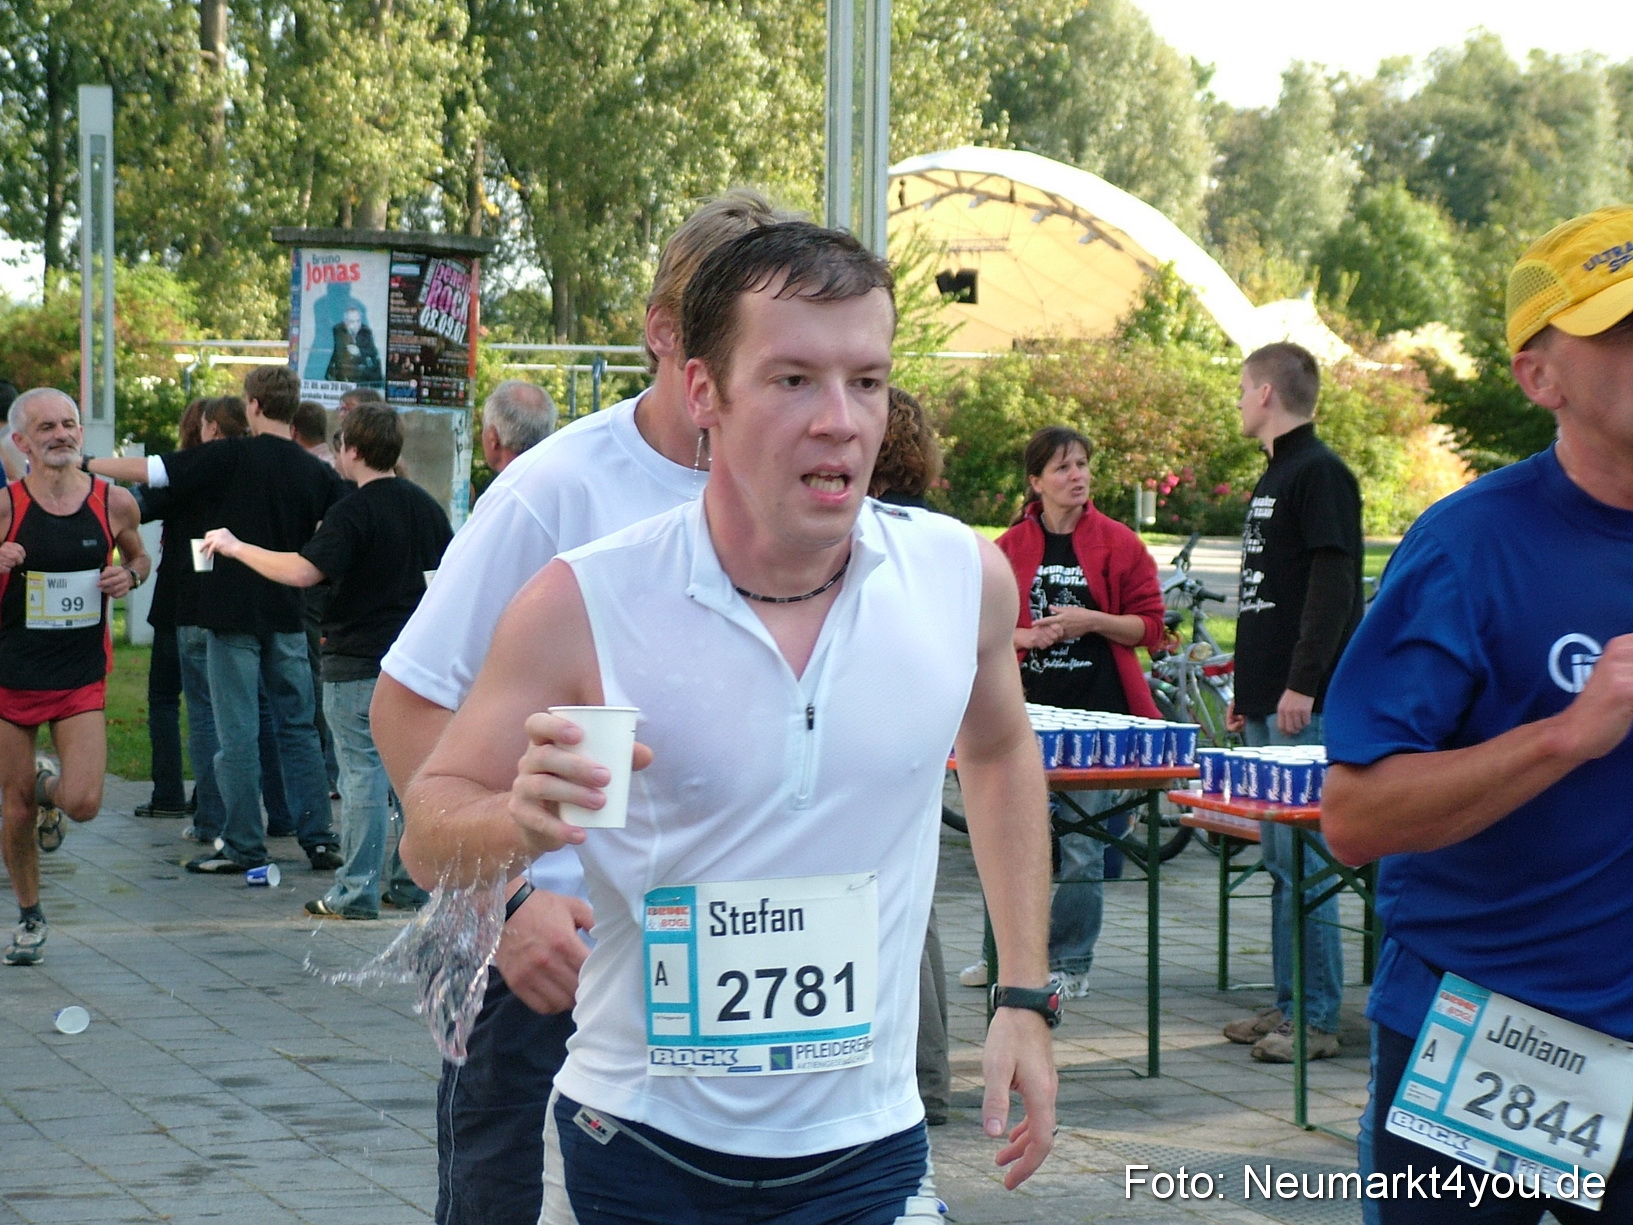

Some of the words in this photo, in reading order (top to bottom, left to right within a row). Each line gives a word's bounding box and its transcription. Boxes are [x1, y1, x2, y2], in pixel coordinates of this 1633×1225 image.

[425, 280, 471, 324] ROCK
[420, 306, 467, 345] 08.09.07
[47, 578, 67, 589] Willi
[61, 596, 84, 612] 99
[709, 897, 805, 937] Stefan
[654, 961, 669, 986] A
[716, 961, 855, 1022] 2781
[651, 1048, 739, 1067] BOCK
[1421, 1039, 1437, 1063] A
[1486, 1015, 1587, 1075] Johann
[1392, 1110, 1472, 1150] BOCK
[1463, 1071, 1604, 1159] 2844
